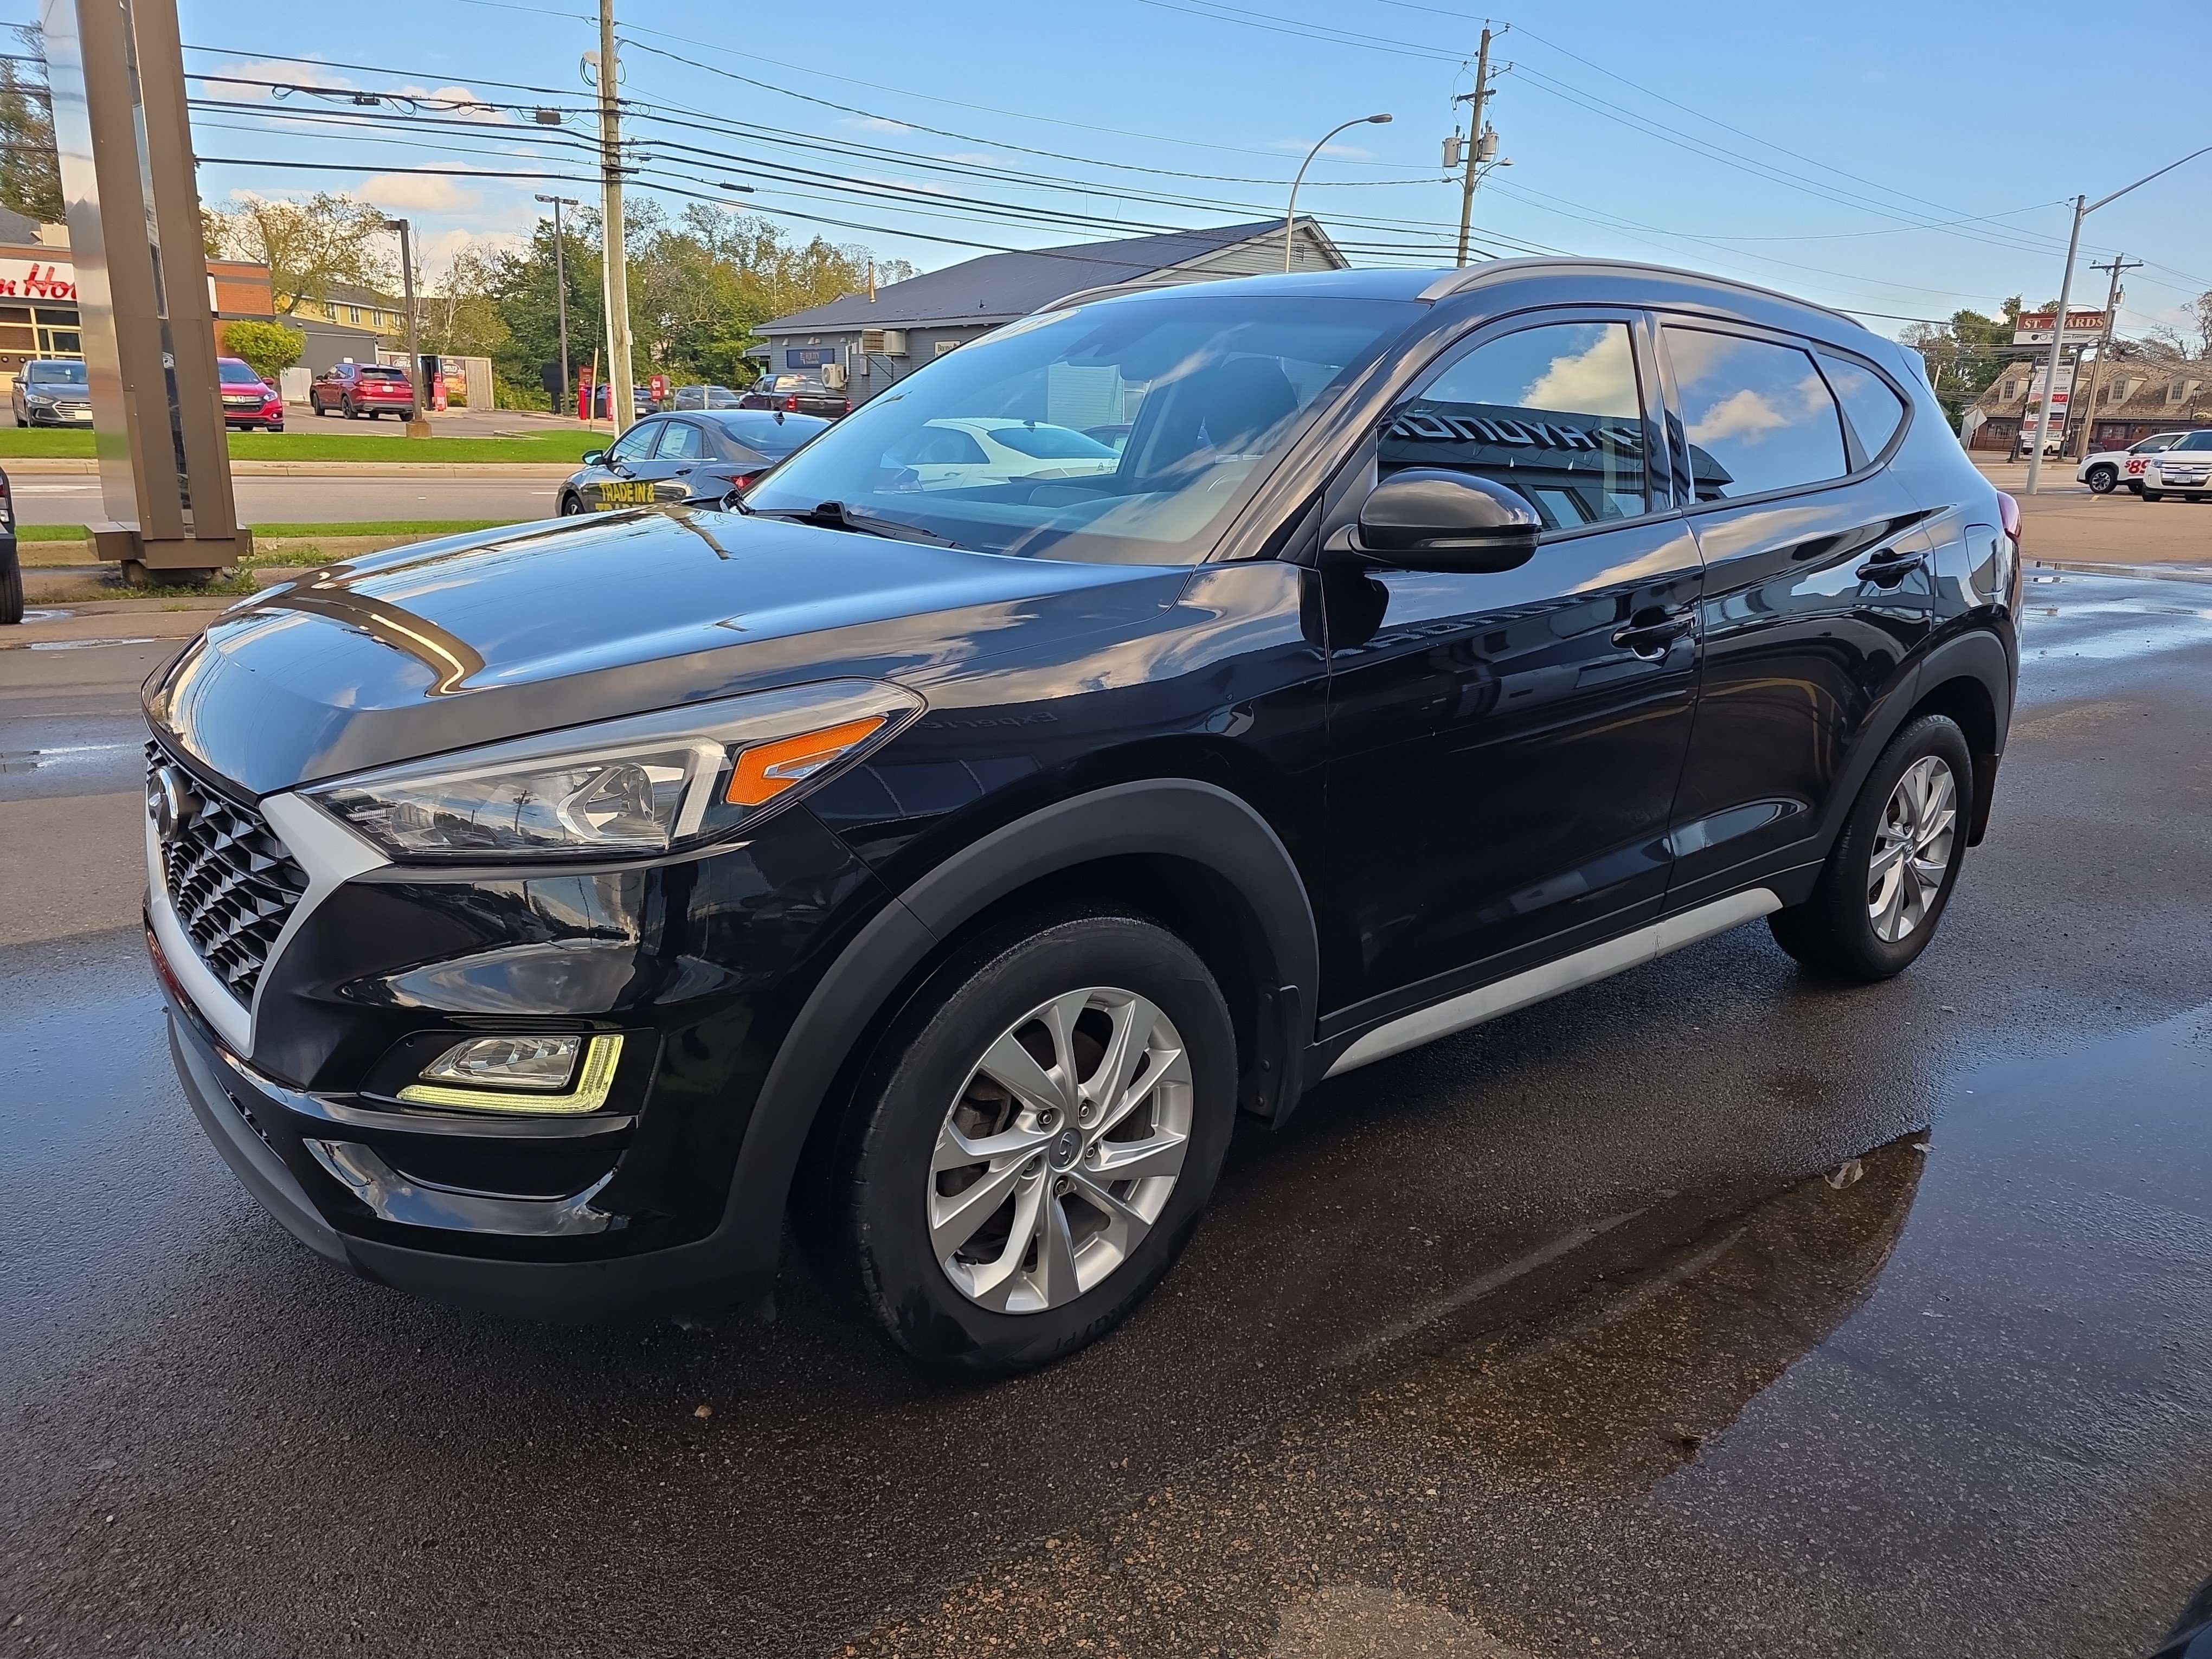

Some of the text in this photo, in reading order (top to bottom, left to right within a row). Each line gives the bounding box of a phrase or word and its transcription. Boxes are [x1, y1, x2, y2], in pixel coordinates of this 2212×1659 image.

[2024, 317, 2104, 329] ST. AARDS
[599, 483, 655, 503] TRADE IN &
